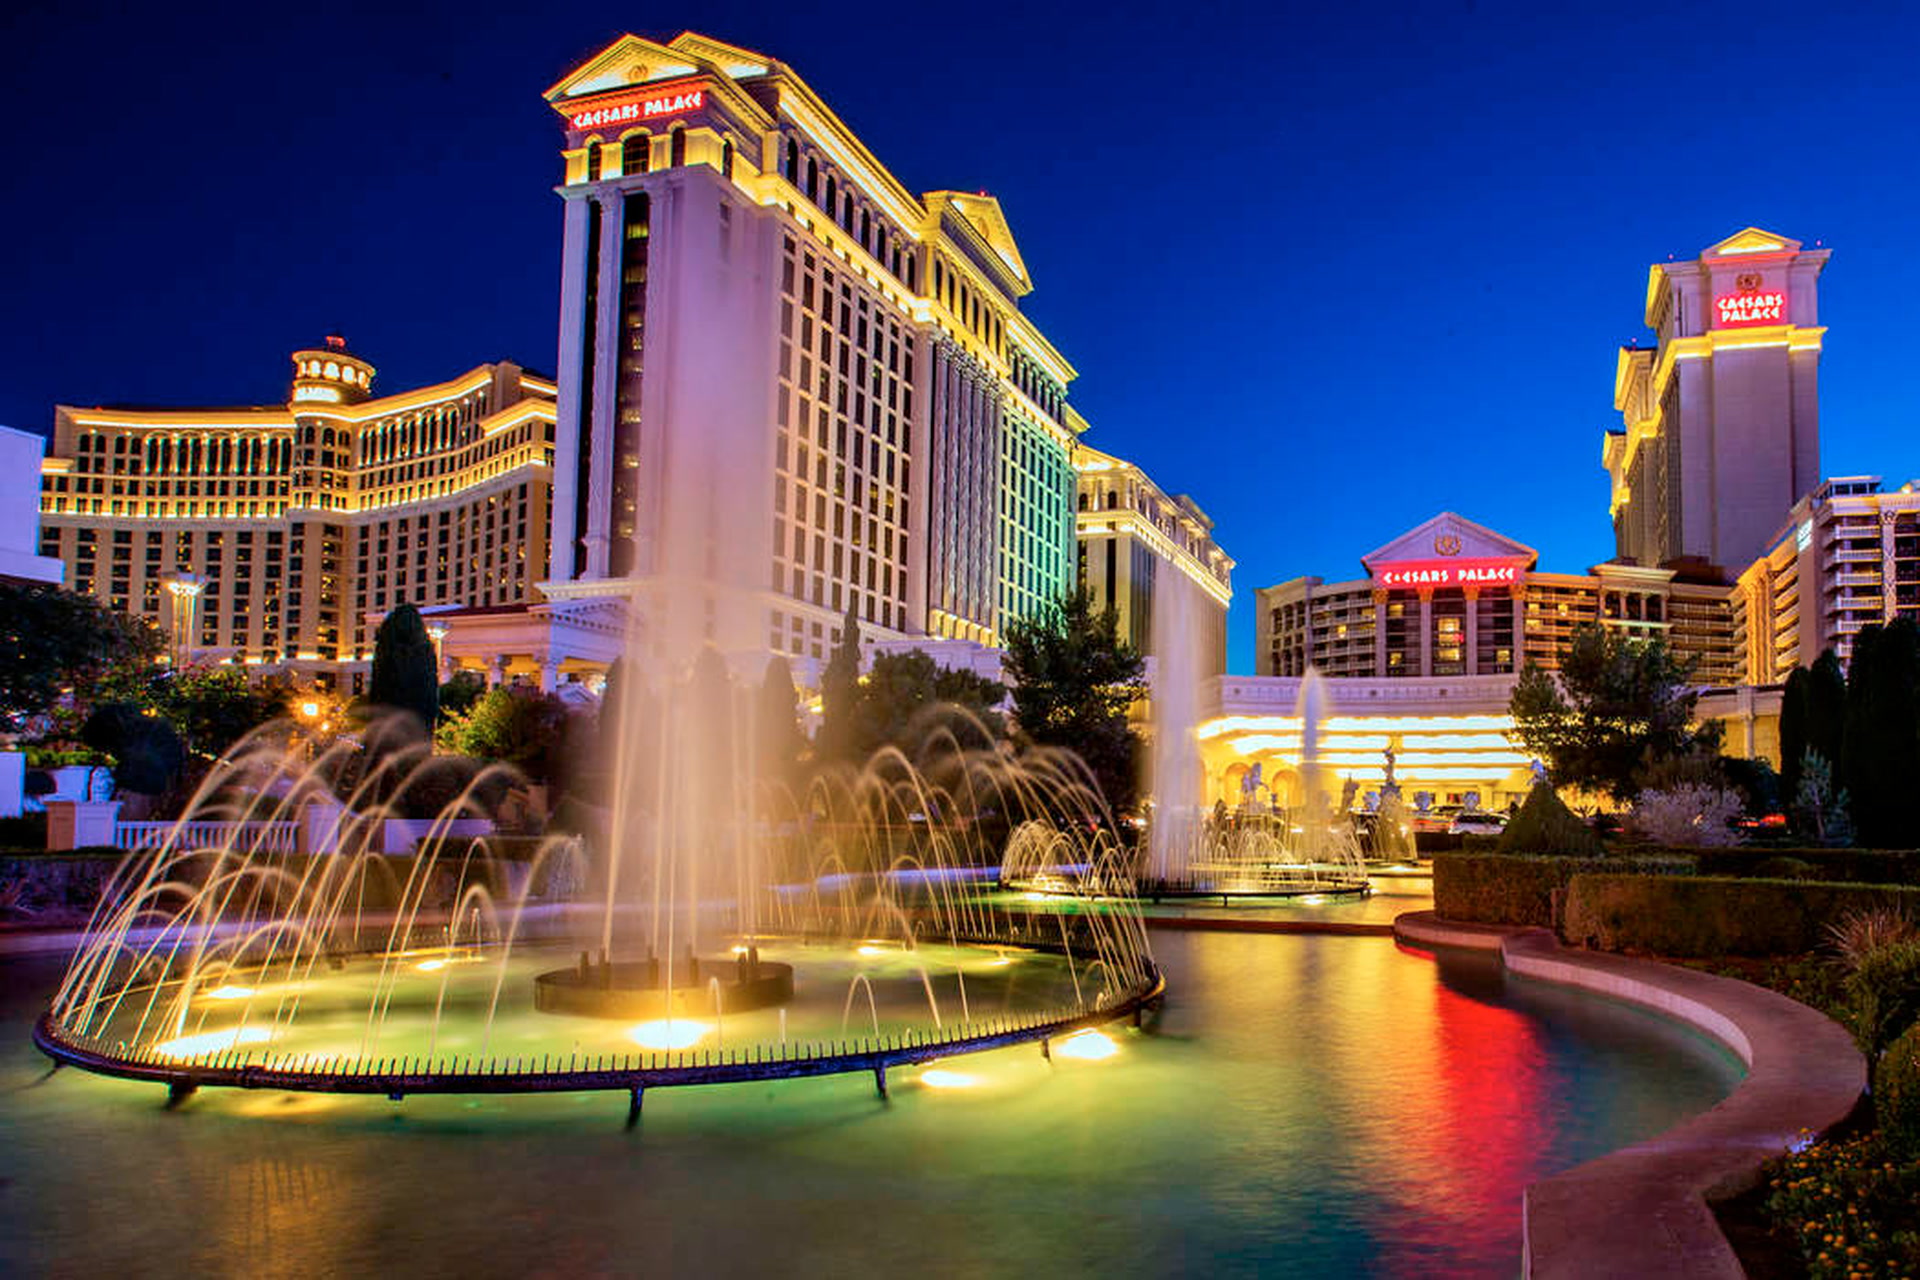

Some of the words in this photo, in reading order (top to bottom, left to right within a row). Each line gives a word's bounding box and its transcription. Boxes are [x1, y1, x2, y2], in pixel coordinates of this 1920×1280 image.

[573, 103, 639, 127] CAESARS
[644, 91, 701, 116] PALACE
[1718, 294, 1783, 309] CAESARS
[1722, 306, 1779, 322] PALACE
[1383, 570, 1449, 584] CAESARS
[1458, 568, 1515, 581] PALACE
